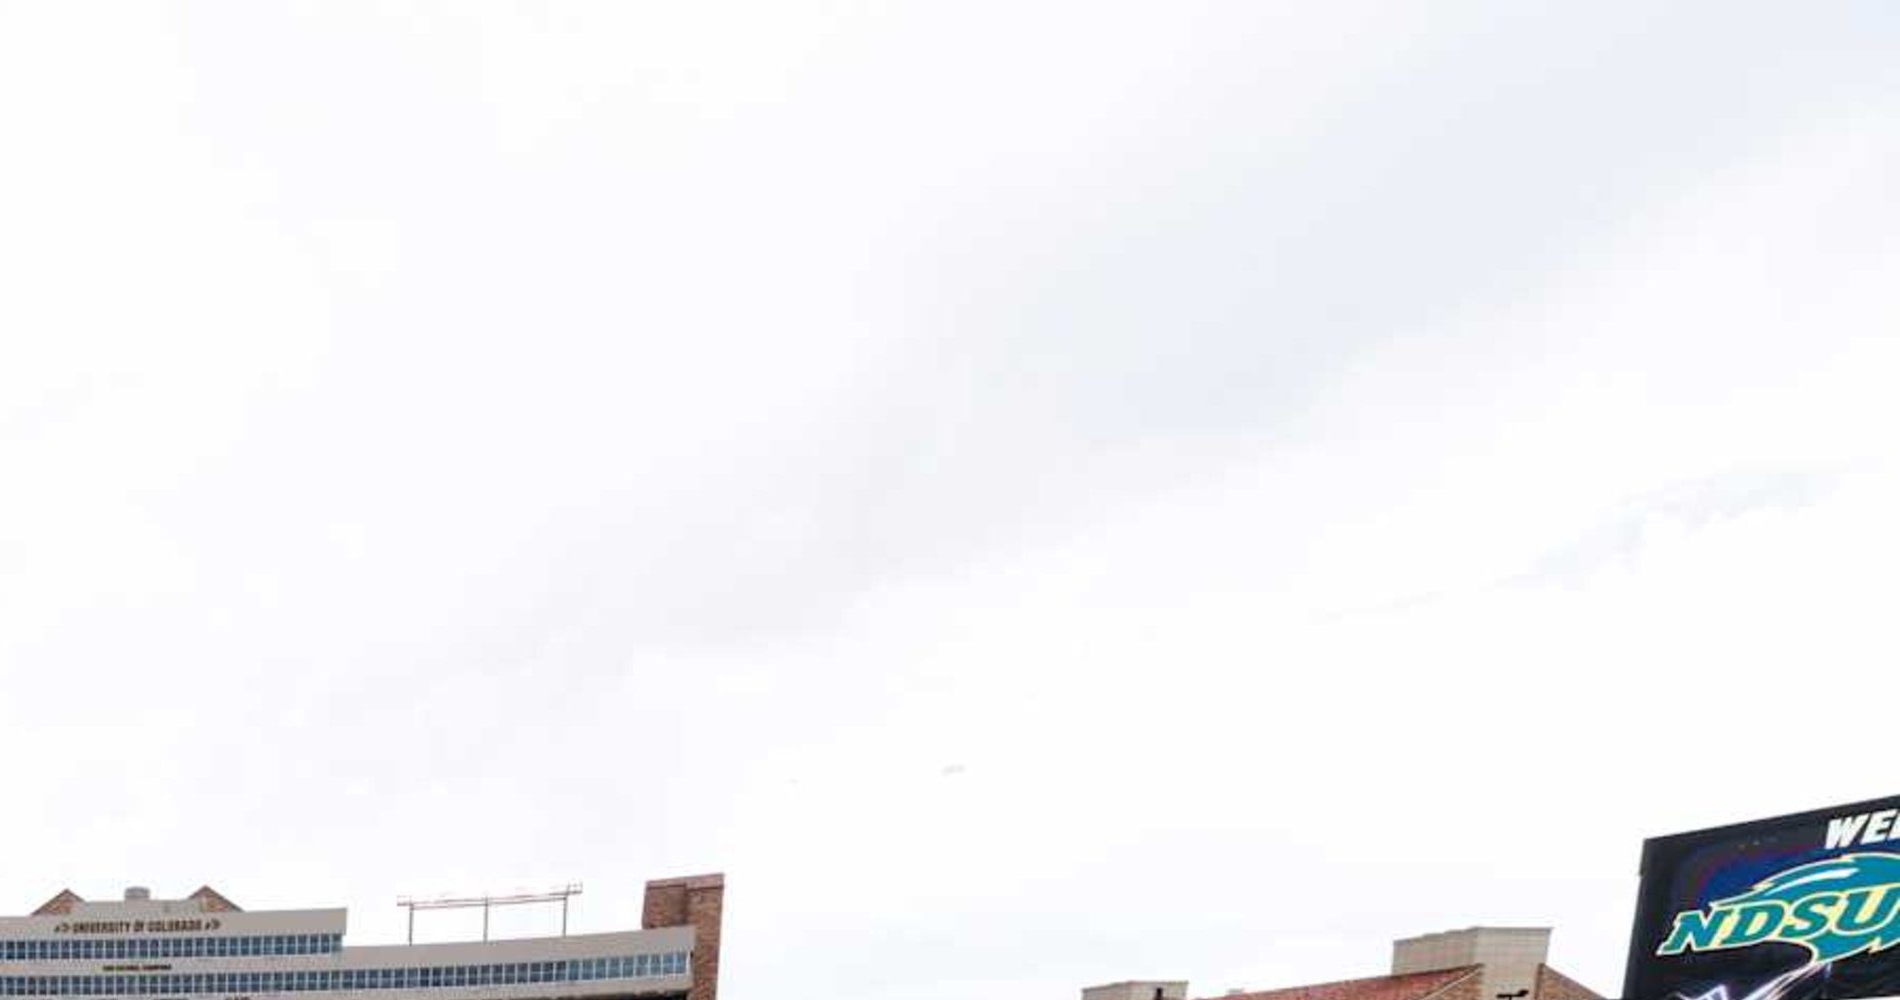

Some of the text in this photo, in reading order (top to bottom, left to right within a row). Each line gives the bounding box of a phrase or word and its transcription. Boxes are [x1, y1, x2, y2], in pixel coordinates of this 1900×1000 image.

[73, 919, 203, 934] UNIVERSITY OF COLORADO
